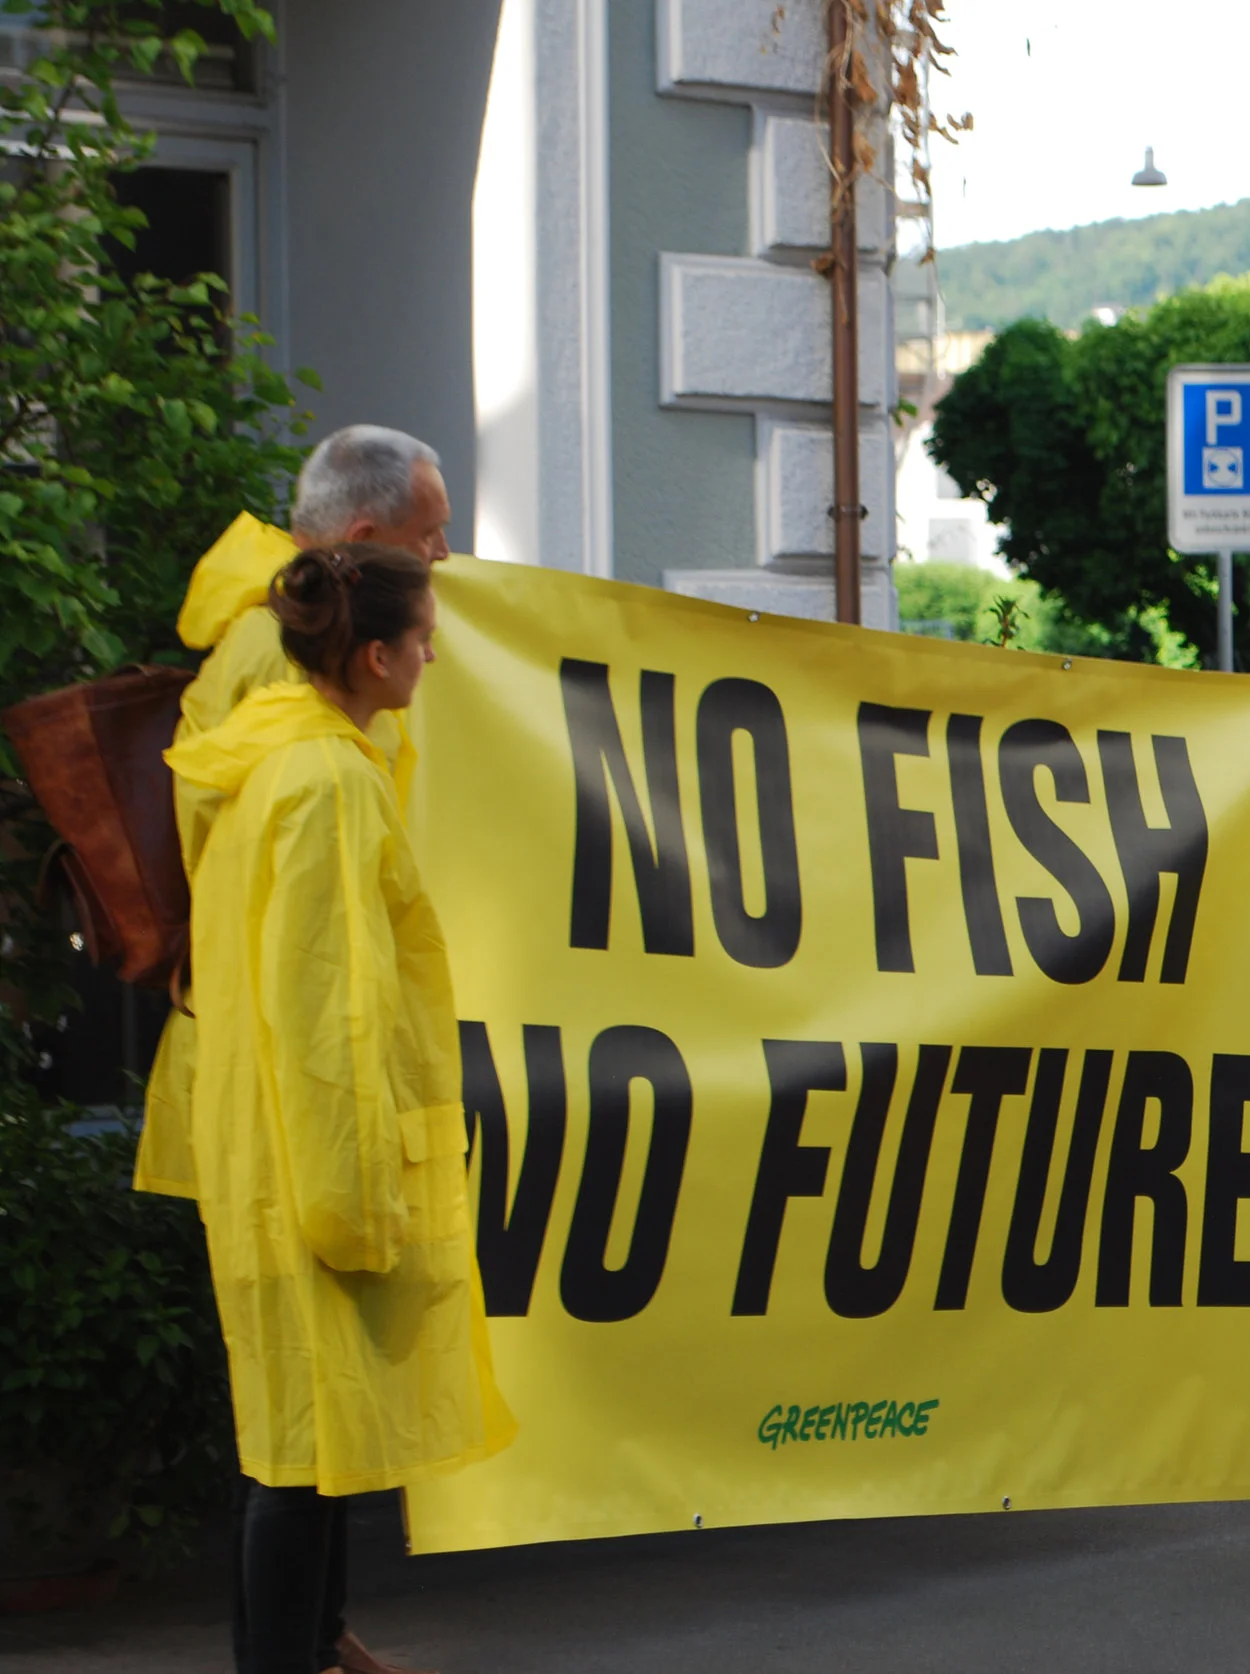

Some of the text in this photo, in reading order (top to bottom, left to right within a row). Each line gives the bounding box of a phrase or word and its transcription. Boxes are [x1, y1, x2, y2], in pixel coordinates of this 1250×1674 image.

[1205, 389, 1243, 446] P
[560, 656, 1210, 986] NO FISH
[456, 1019, 694, 1323] NO
[758, 1398, 940, 1451] GREENPEACE
